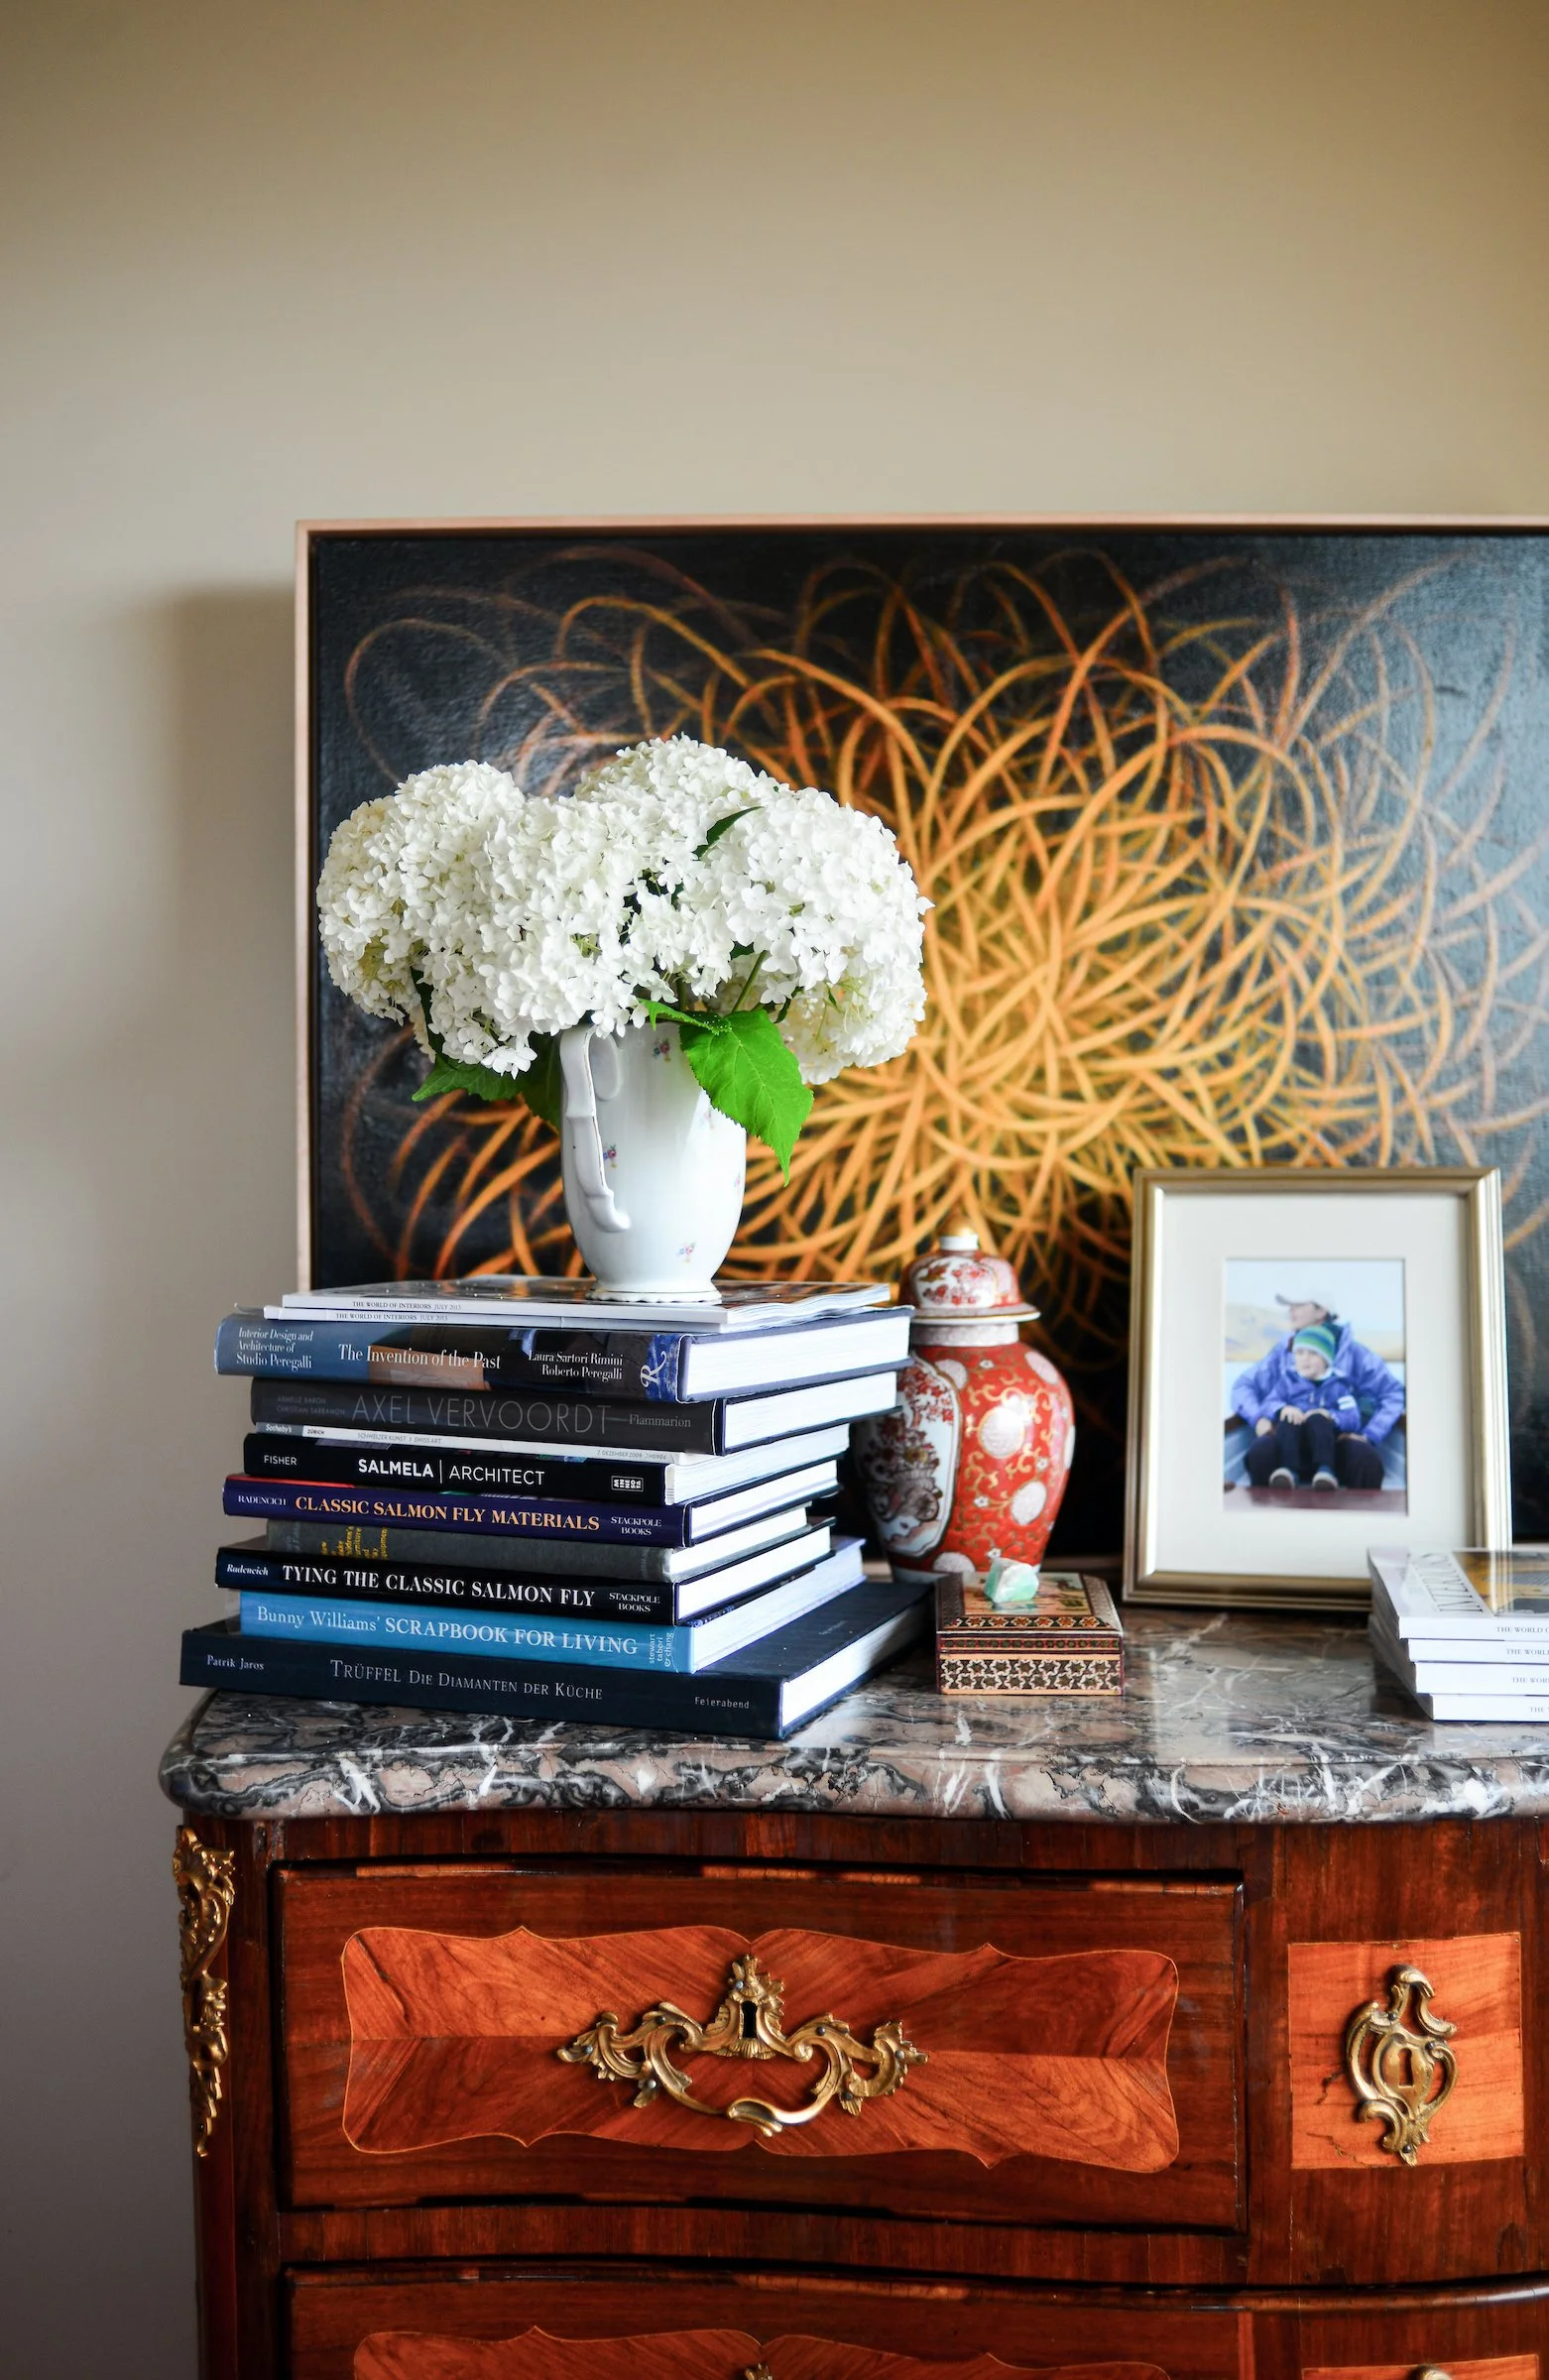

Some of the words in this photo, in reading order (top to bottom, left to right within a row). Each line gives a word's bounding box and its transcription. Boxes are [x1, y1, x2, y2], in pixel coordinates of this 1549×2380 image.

[238, 1327, 269, 1339] Interior
[270, 1329, 297, 1343] Design
[298, 1331, 313, 1342] and
[238, 1340, 285, 1353] Architecture
[286, 1342, 296, 1354] of
[236, 1352, 268, 1366] Studio
[270, 1354, 312, 1371] Peregalli
[338, 1344, 363, 1362] The
[367, 1345, 428, 1366] Invention
[431, 1349, 446, 1366] of
[448, 1350, 469, 1368] the
[473, 1351, 501, 1369] Past
[529, 1350, 554, 1363] Laura
[556, 1351, 588, 1365] Sartori
[590, 1353, 623, 1366] Rimini
[541, 1364, 580, 1377] Roberto
[581, 1367, 623, 1382] Peregalli
[640, 1351, 667, 1388] R
[352, 1394, 416, 1425] AXEL
[427, 1396, 612, 1434] VERVOORDT
[629, 1413, 692, 1428] Flammarion
[357, 1432, 388, 1441] SCHWEIZER
[264, 1455, 298, 1467] FISHER
[358, 1459, 434, 1478] SALMELA
[448, 1465, 545, 1486] ARCHITECT
[237, 1494, 287, 1507] RADENCICH
[295, 1496, 370, 1515] CLASSIC
[373, 1501, 447, 1520] SALMON
[452, 1506, 486, 1523] FLY
[491, 1509, 600, 1531] MATERIALS
[610, 1515, 662, 1527] STACKPOLE
[621, 1526, 652, 1536] BOOKS
[226, 1563, 270, 1577] Radencich
[283, 1565, 337, 1585] TYING
[343, 1570, 380, 1589] THE
[385, 1574, 465, 1597] CLASSIC
[471, 1581, 553, 1605] SALMON
[559, 1589, 596, 1607] FLY
[609, 1592, 661, 1605] STACKPOLE
[618, 1603, 652, 1613] BOOKS
[257, 1606, 304, 1629] Bunny
[309, 1610, 381, 1632] Williams'
[385, 1616, 509, 1644] SCRAPBOOK
[514, 1628, 556, 1648] FOR
[562, 1632, 639, 1655] LIVING
[663, 1632, 674, 1658] chang
[206, 1654, 236, 1668] Patrik
[239, 1657, 265, 1671] Jaros
[330, 1659, 402, 1683] TRÜFFEL
[437, 1672, 519, 1693] DIAMANTEN
[554, 1682, 603, 1701] KÜCHE
[694, 1696, 751, 1710] Feierabend
